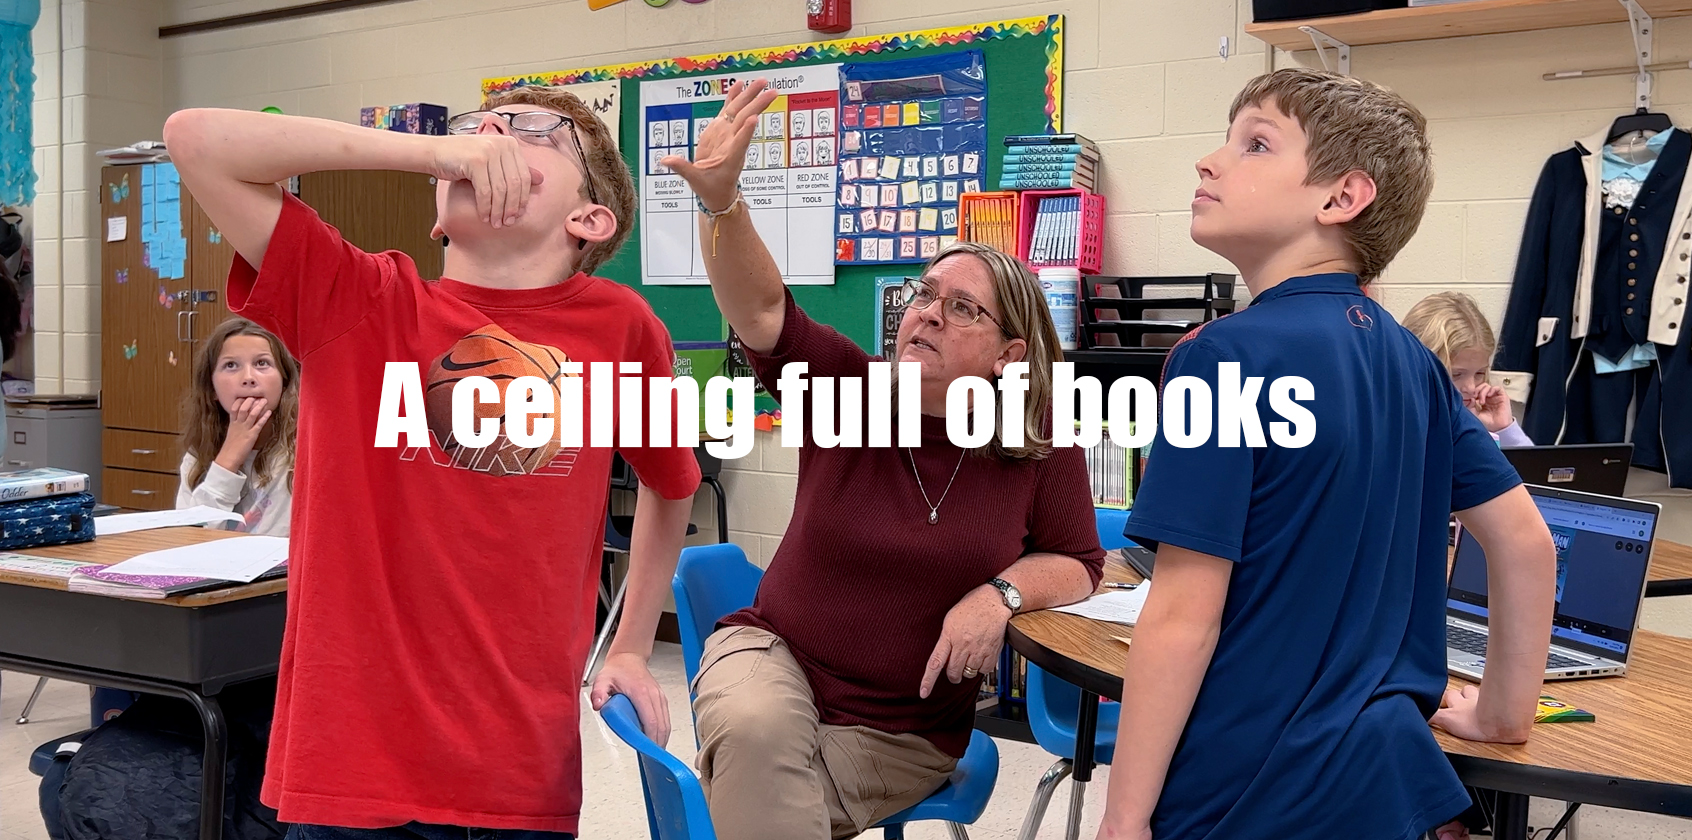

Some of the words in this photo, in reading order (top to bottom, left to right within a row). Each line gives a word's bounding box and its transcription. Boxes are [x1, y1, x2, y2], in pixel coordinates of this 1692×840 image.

[676, 86, 692, 98] The
[849, 85, 860, 97] 24
[908, 161, 914, 173] 4
[927, 161, 933, 173] 5
[948, 159, 955, 171] 6
[967, 157, 974, 169] 7
[741, 175, 767, 185] YELLOW
[767, 174, 785, 184] ZONE
[797, 173, 810, 182] RED
[810, 172, 830, 182] ZONE
[654, 181, 668, 189] BLUE
[668, 179, 685, 188] ZONE
[845, 189, 851, 201] 8
[865, 188, 871, 203] 9
[884, 189, 894, 202] 10
[925, 187, 933, 199] 12
[946, 185, 954, 197] 13
[968, 183, 977, 192] 14
[753, 198, 772, 206] TOOLS
[801, 196, 822, 204] TOOLS
[842, 217, 850, 229] 15
[864, 215, 873, 226] 16
[883, 215, 893, 227] 17
[904, 215, 912, 227] 18
[923, 214, 932, 225] 19
[943, 212, 955, 226] 20
[903, 241, 913, 253] 25
[923, 241, 934, 253] 26
[884, 338, 894, 346] you
[672, 365, 695, 377] ourt
[399, 429, 584, 477] NIKE
[1, 486, 29, 500] Odder
[1552, 531, 1570, 550] MAN
